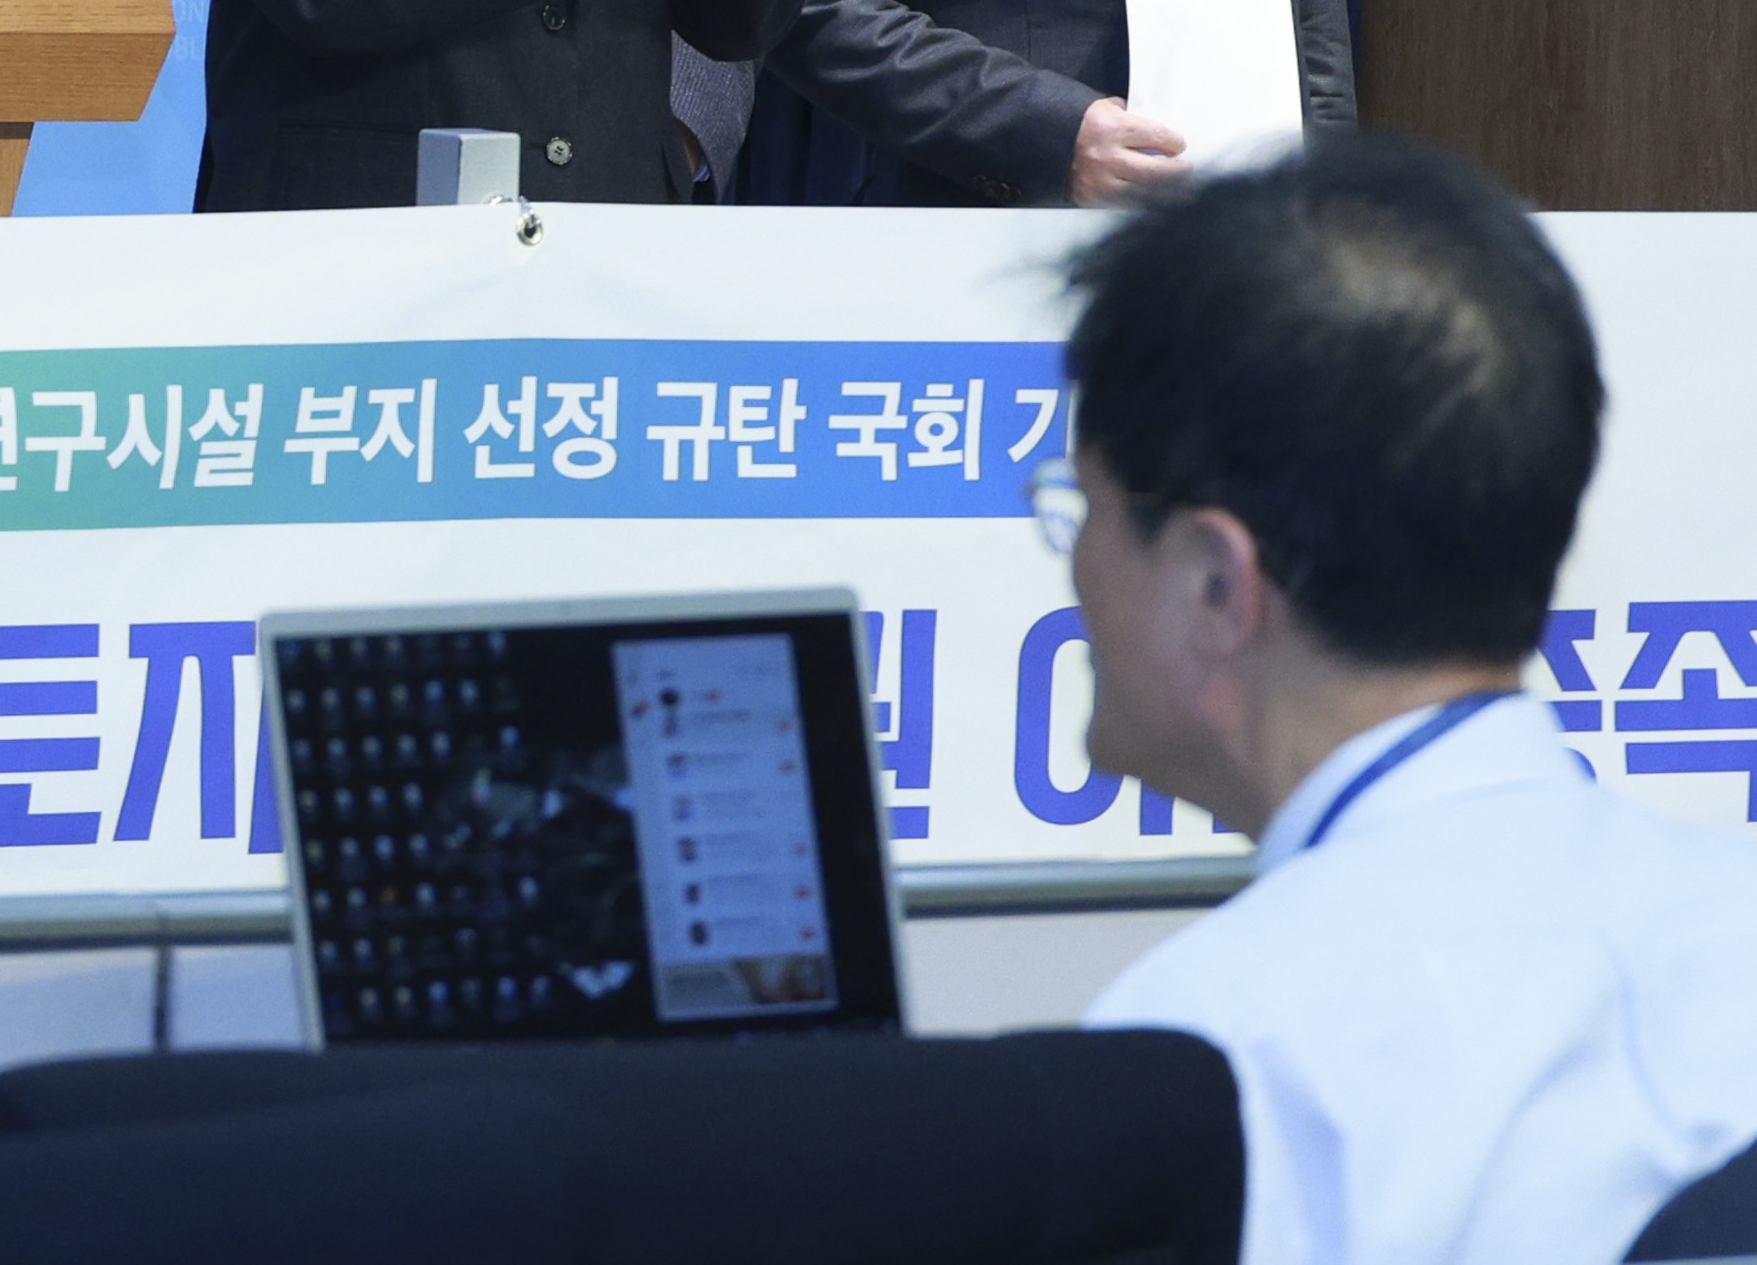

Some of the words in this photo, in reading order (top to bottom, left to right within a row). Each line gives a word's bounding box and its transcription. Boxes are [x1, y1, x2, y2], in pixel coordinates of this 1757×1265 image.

[284, 378, 437, 486] 부지
[463, 375, 620, 480] 선정
[646, 378, 807, 482] 규탄
[827, 378, 985, 481] 국회
